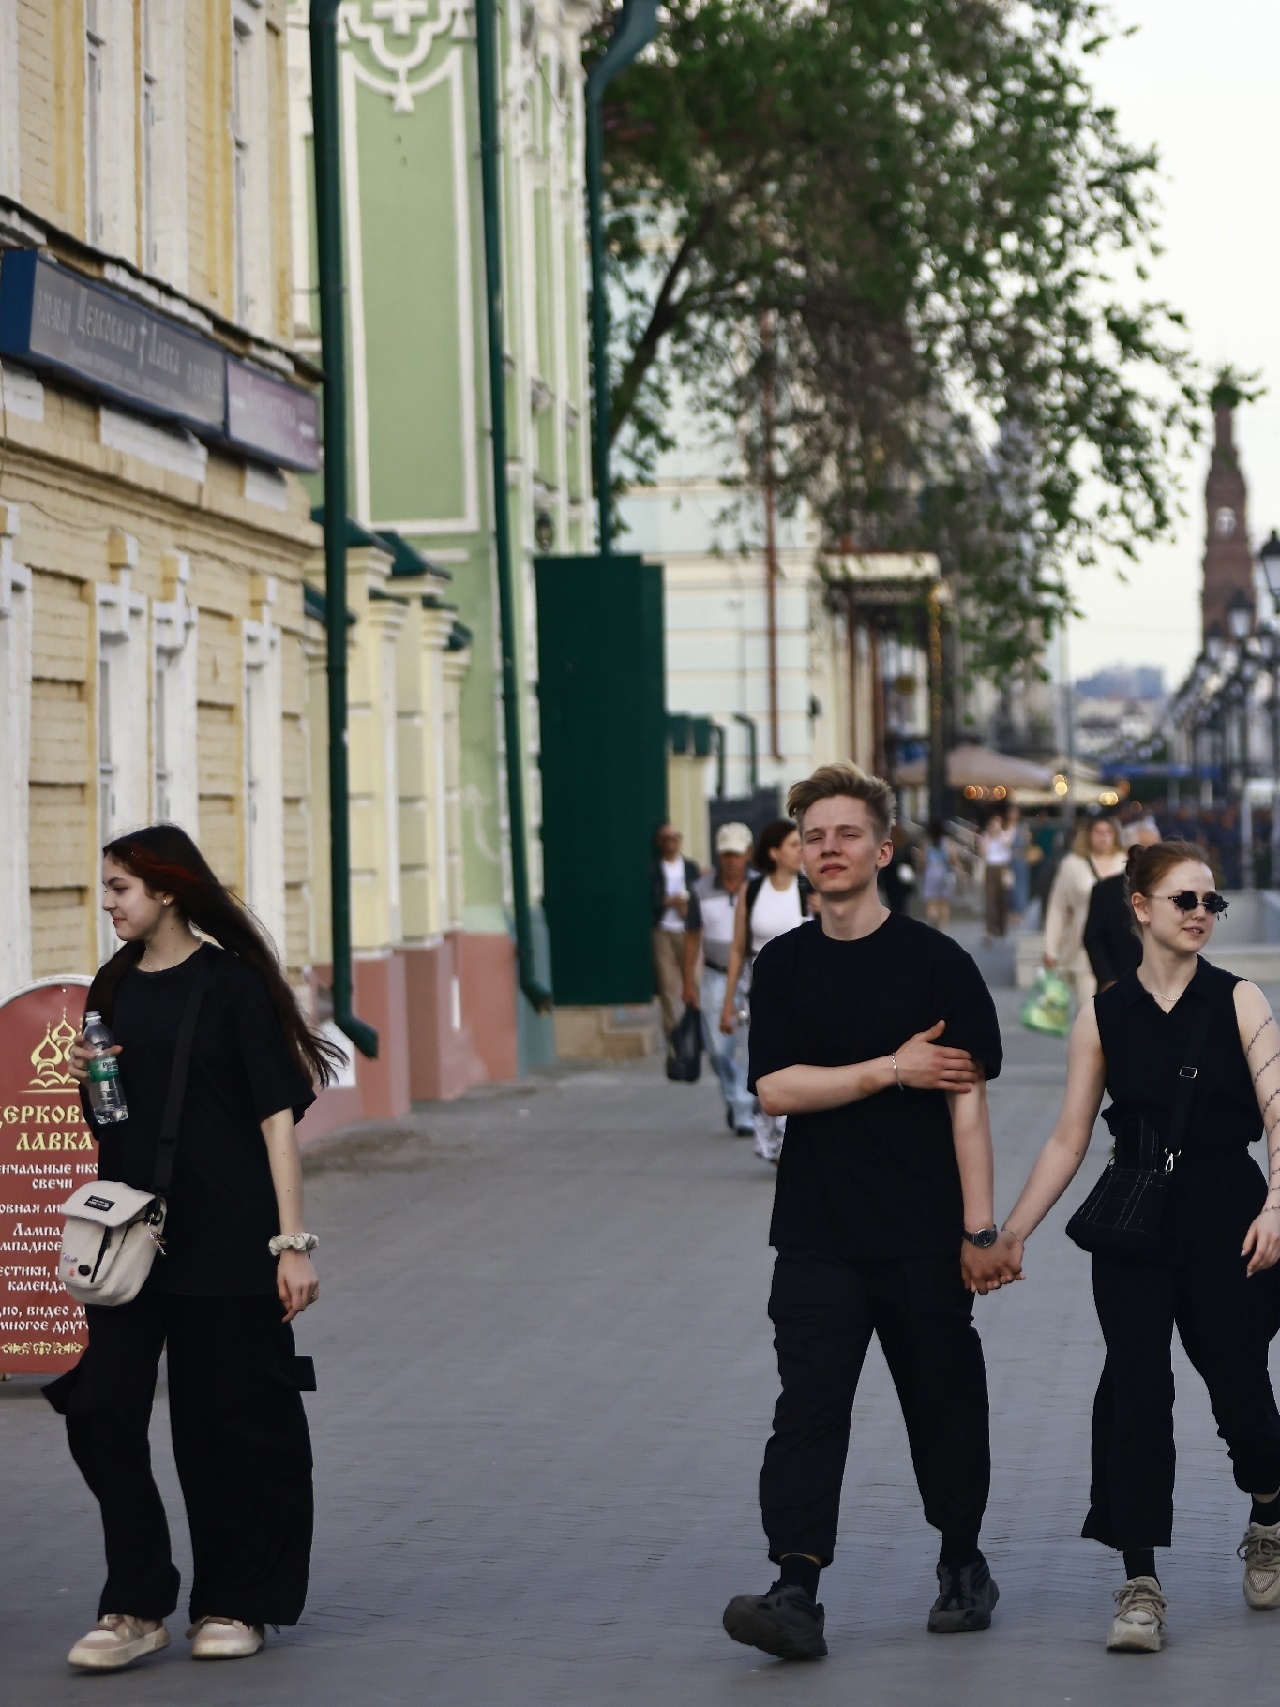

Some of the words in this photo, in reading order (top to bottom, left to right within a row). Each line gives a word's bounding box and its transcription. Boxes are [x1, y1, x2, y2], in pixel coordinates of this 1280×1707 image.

[0, 1105, 86, 1129] ЕРКОВ
[16, 1132, 94, 1151] ЛАВКА
[13, 1223, 63, 1237] Лампа
[8, 1281, 69, 1294] календа
